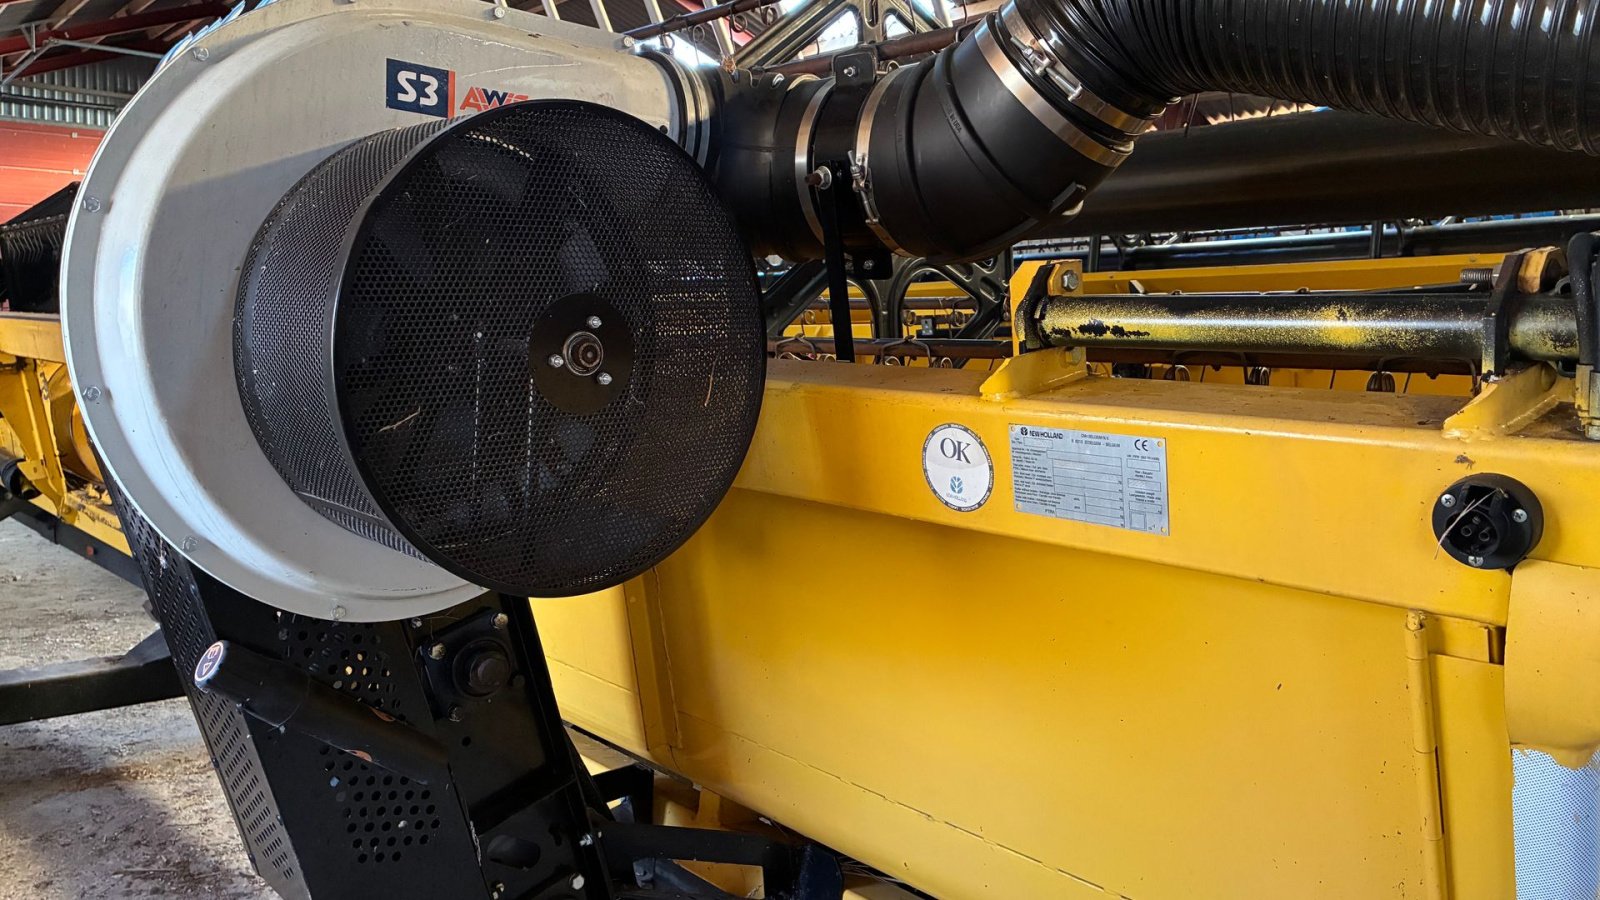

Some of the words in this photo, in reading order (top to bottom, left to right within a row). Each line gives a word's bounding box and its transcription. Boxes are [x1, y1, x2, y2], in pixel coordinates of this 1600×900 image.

[397, 70, 439, 106] S3
[1040, 431, 1063, 439] HOLLAND
[940, 437, 971, 464] OK
[1134, 439, 1149, 451] CE
